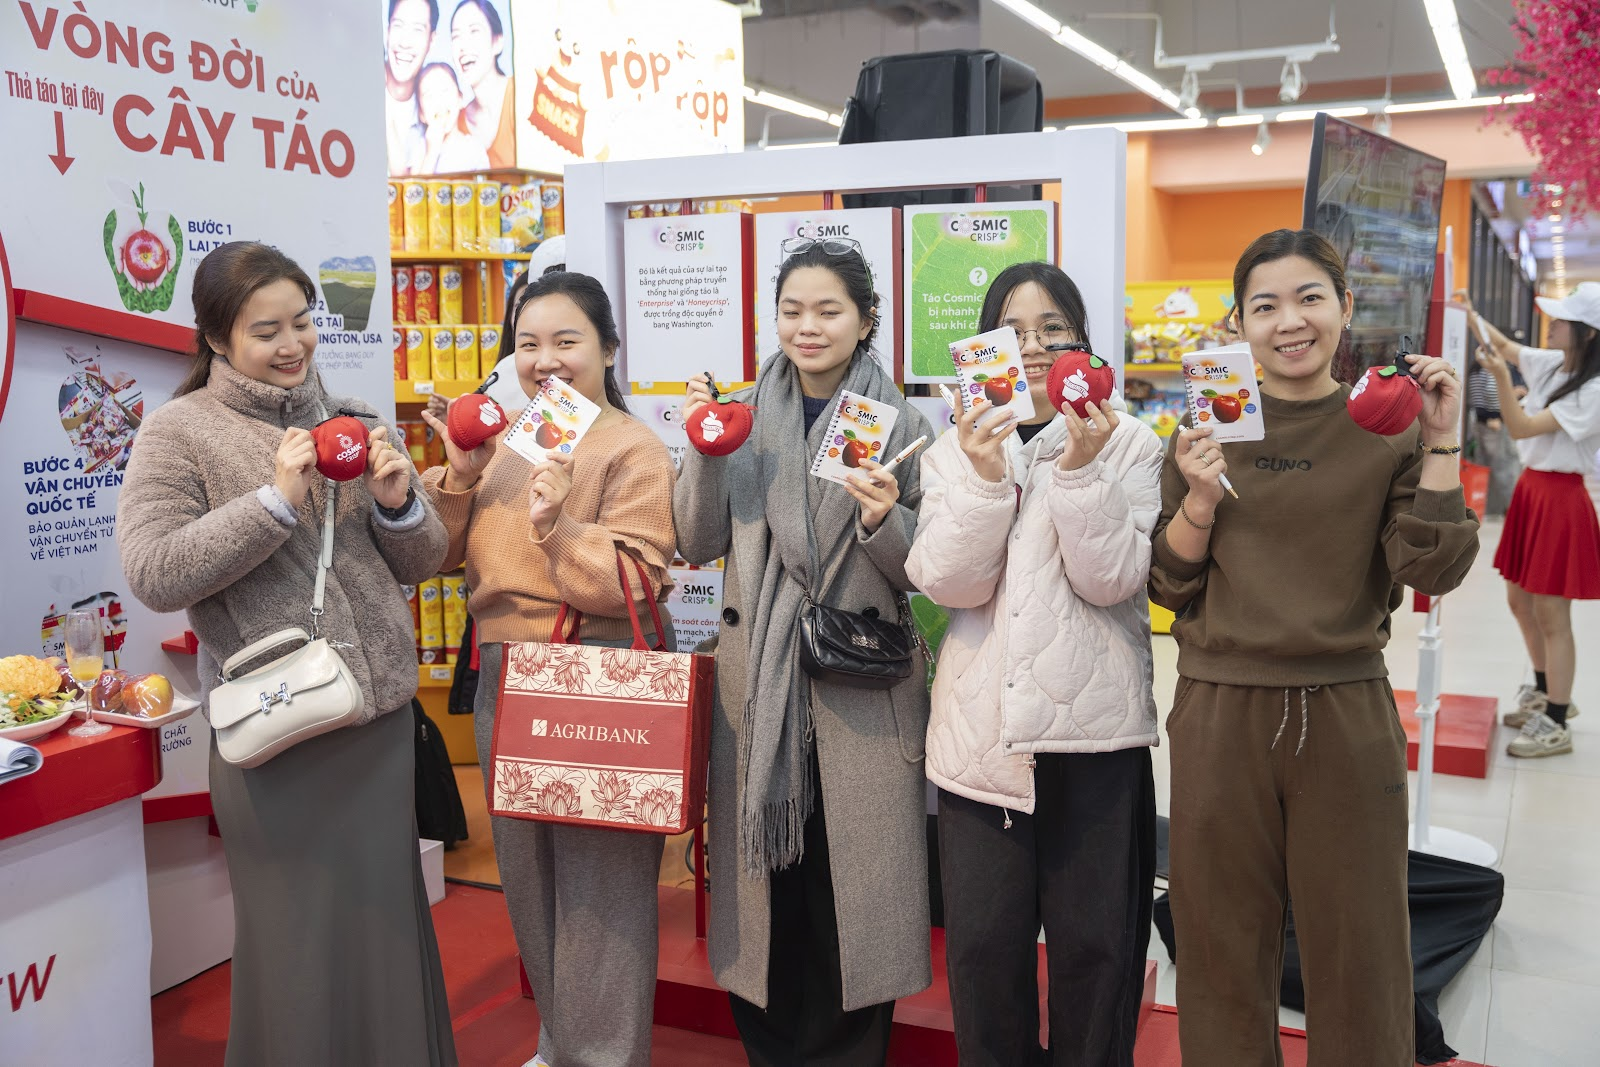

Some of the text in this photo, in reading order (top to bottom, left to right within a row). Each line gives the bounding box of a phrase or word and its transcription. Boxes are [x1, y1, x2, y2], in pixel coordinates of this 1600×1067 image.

[18, 1, 320, 103] VÒNG ĐỜI CỦA
[600, 38, 670, 102] rộp
[5, 70, 104, 115] Thả táo tại đây
[676, 80, 728, 136] rộp
[112, 86, 356, 178] CÂY TÁO
[188, 219, 232, 235] BƯỚC 1
[970, 232, 998, 242] CRISP
[190, 240, 208, 252] LAI
[675, 242, 696, 252] CRISP
[639, 267, 648, 275] Đó
[656, 266, 668, 274] kết
[669, 266, 682, 276] quả
[682, 266, 694, 274] của
[696, 266, 704, 274] sự
[706, 265, 714, 273] lai
[716, 266, 728, 274] tạo
[658, 278, 684, 287] phương
[685, 276, 702, 286] pháp
[648, 286, 666, 297] thống
[680, 286, 698, 296] giống
[922, 292, 982, 302] Táo Cosmic
[318, 300, 324, 310] 2
[644, 310, 660, 320] được
[682, 310, 694, 318] độc
[718, 308, 724, 316] ở
[928, 306, 938, 318] bị
[942, 306, 974, 316] nhanh
[326, 318, 342, 330] TẠI
[654, 320, 714, 330] bang Washington.
[950, 320, 966, 330] khi
[318, 333, 360, 346] INGTON,
[363, 333, 382, 344] USA
[336, 442, 362, 460] COSMIC
[24, 456, 70, 474] BƯỚC
[74, 458, 84, 470] 4
[1256, 457, 1312, 472] GUNO
[25, 468, 124, 497] VẬN CHUYỂN
[26, 490, 96, 515] QUỐC TẾ
[29, 514, 116, 534] BẢO QUẢN LẠNH
[54, 528, 97, 544] CHUYỂN
[100, 526, 114, 538] TỪ
[48, 546, 70, 558] VIỆT
[74, 544, 98, 554] NAM
[683, 584, 714, 596] SMIC
[682, 596, 706, 604] CRISP
[682, 618, 698, 626] soát
[684, 629, 706, 638] mạch,
[164, 724, 187, 740] CHẤT
[550, 723, 650, 744] AGRIBANK
[162, 736, 192, 752] RƯỜNG
